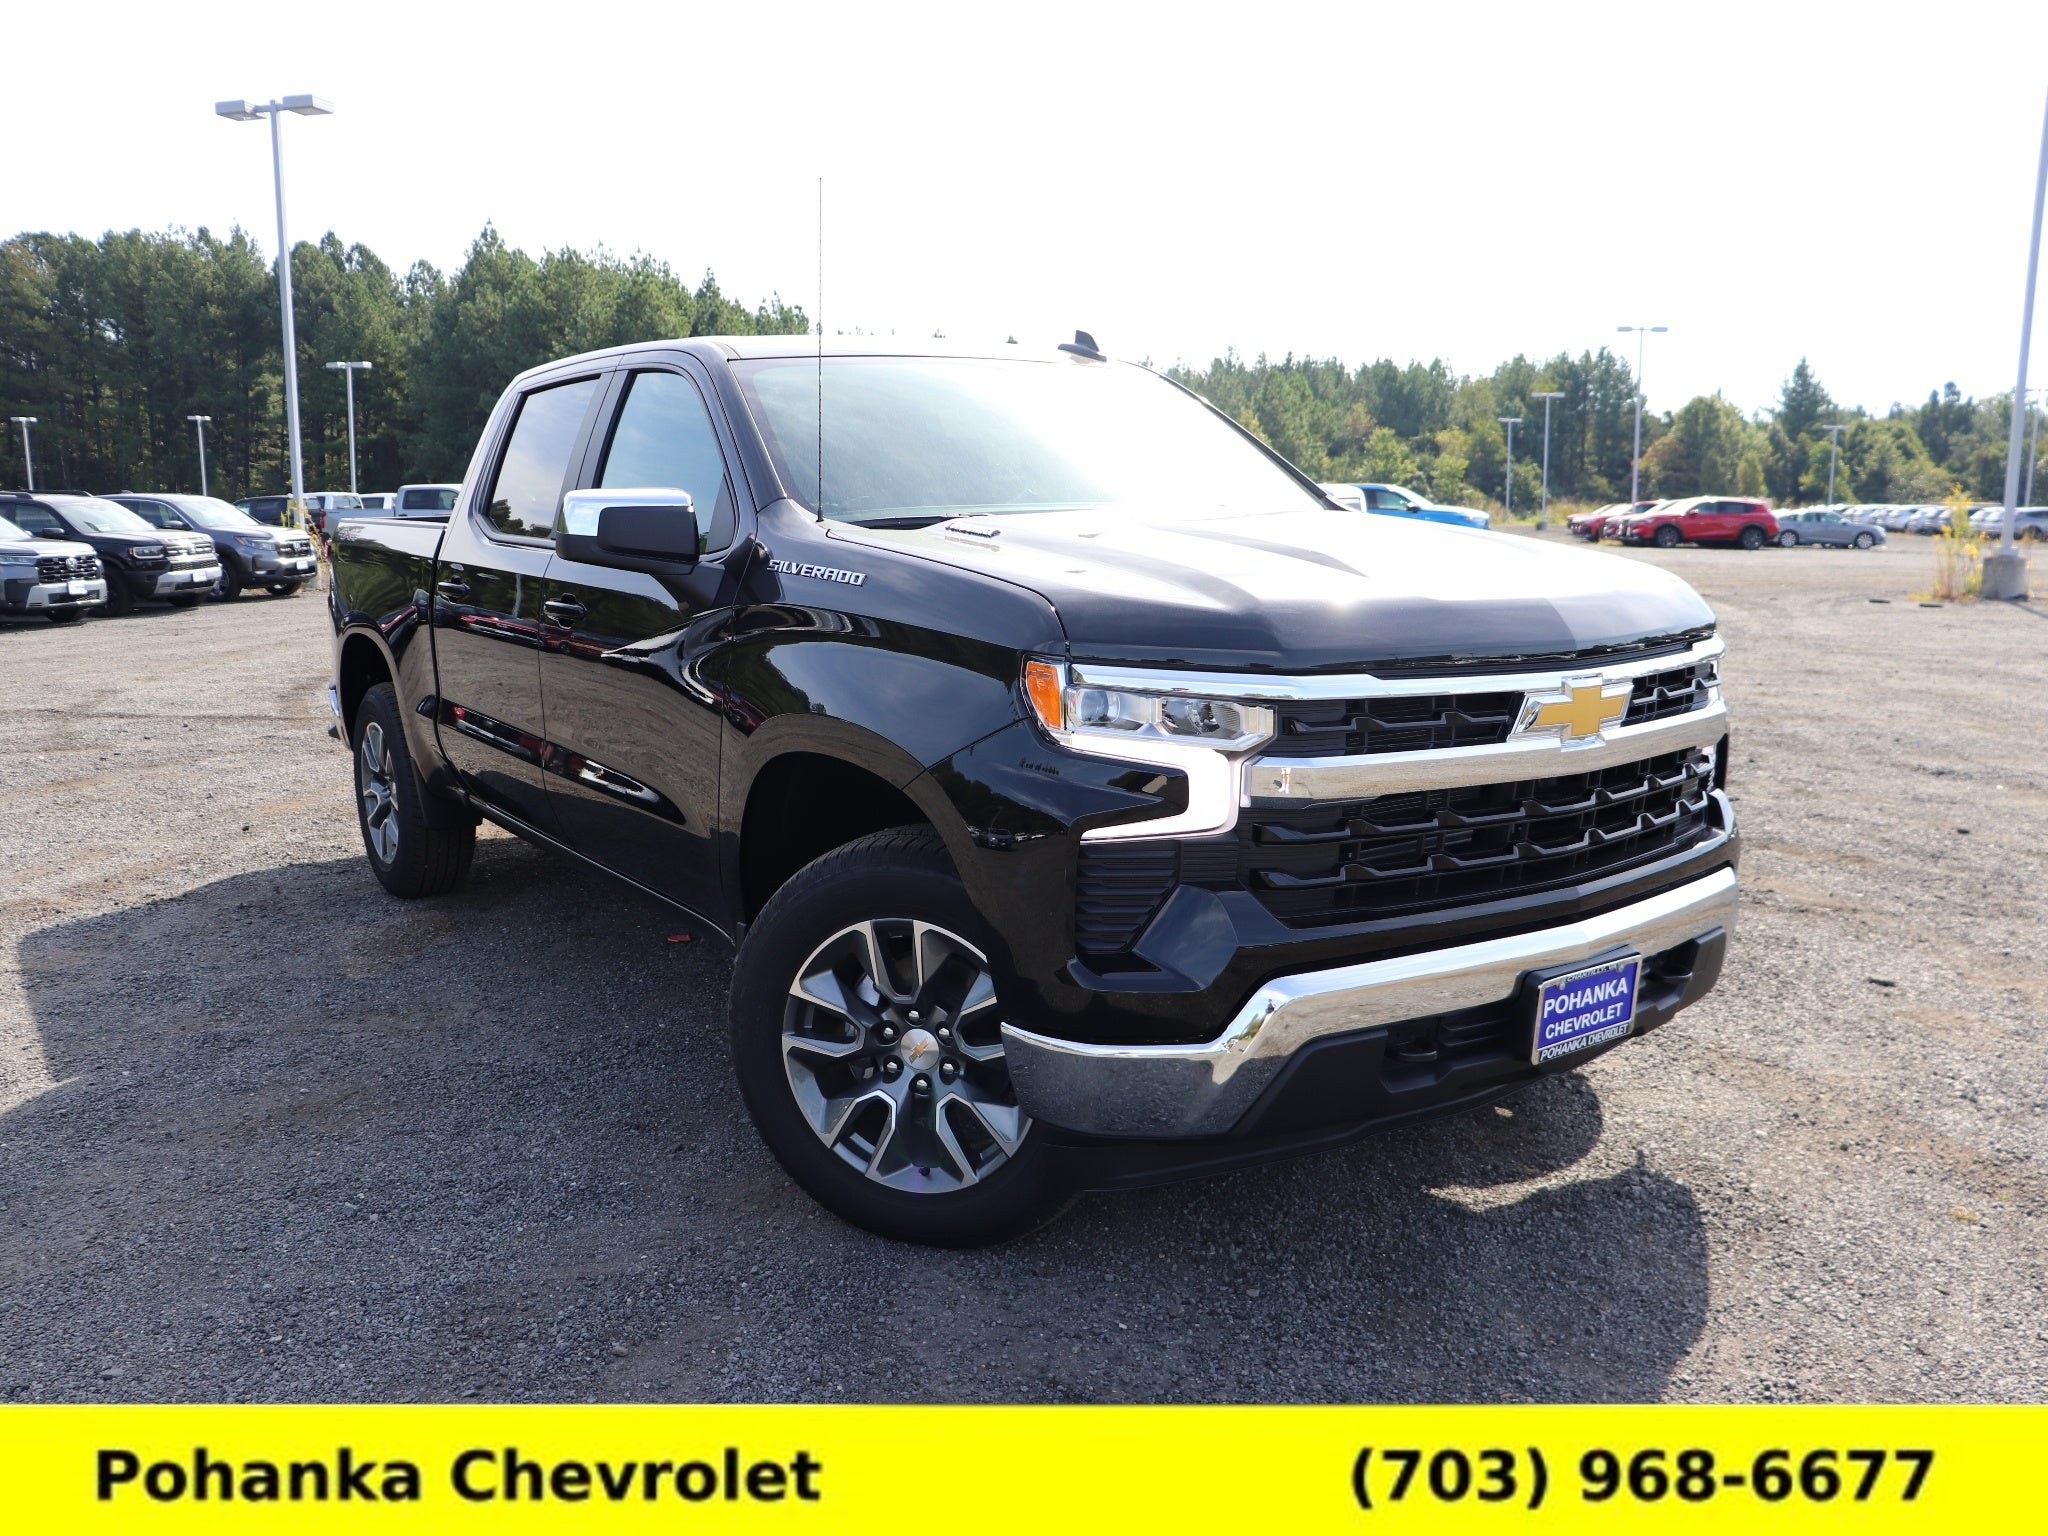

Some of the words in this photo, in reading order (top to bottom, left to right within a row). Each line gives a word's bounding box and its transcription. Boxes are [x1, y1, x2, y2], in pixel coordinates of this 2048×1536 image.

[767, 559, 866, 586] SILVERADO
[1543, 977, 1628, 1018] POHANKA
[1545, 1002, 1624, 1039] CHEVROLET
[1540, 1037, 1587, 1061] POHANKA
[1588, 1023, 1629, 1046] CHEVROLET
